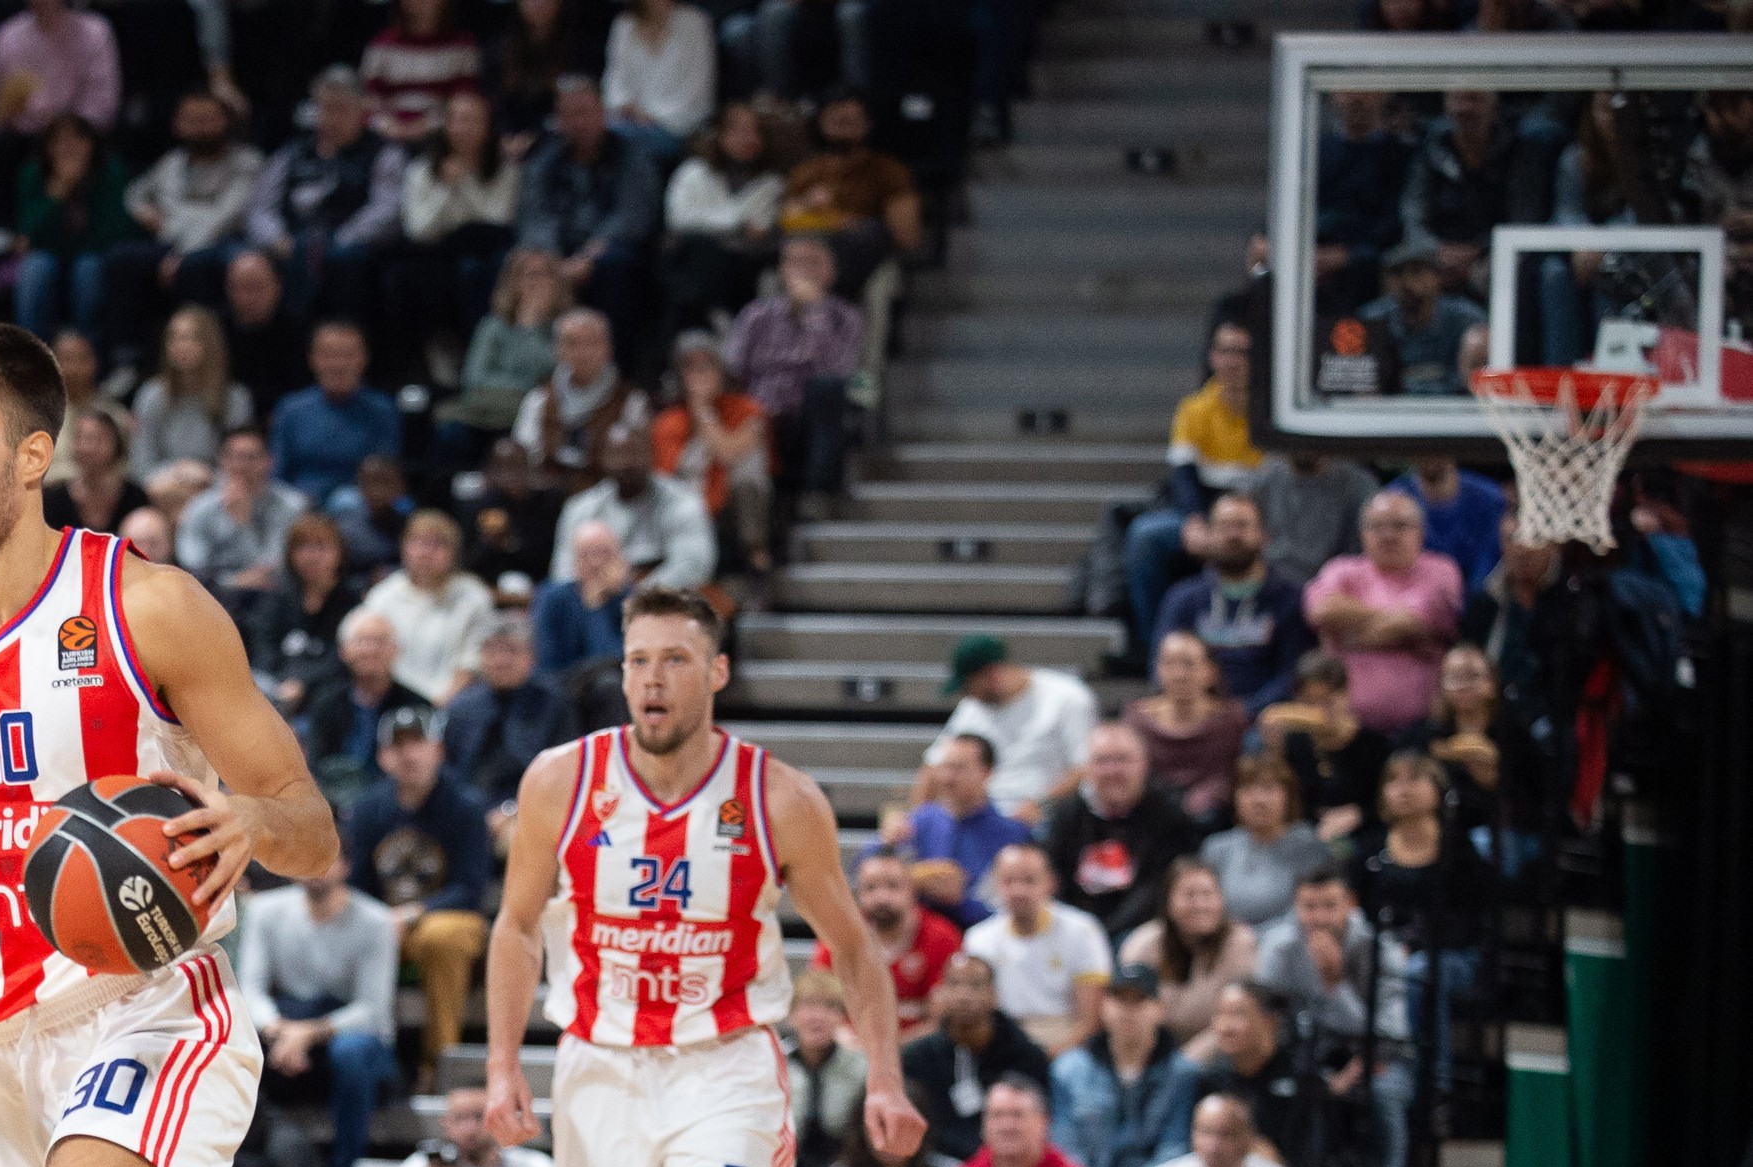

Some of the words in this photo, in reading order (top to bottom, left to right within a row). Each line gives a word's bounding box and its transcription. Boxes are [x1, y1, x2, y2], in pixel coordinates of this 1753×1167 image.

[628, 857, 692, 910] 24
[590, 920, 734, 954] meridian
[611, 964, 710, 1005] mts
[61, 1058, 148, 1120] 30
